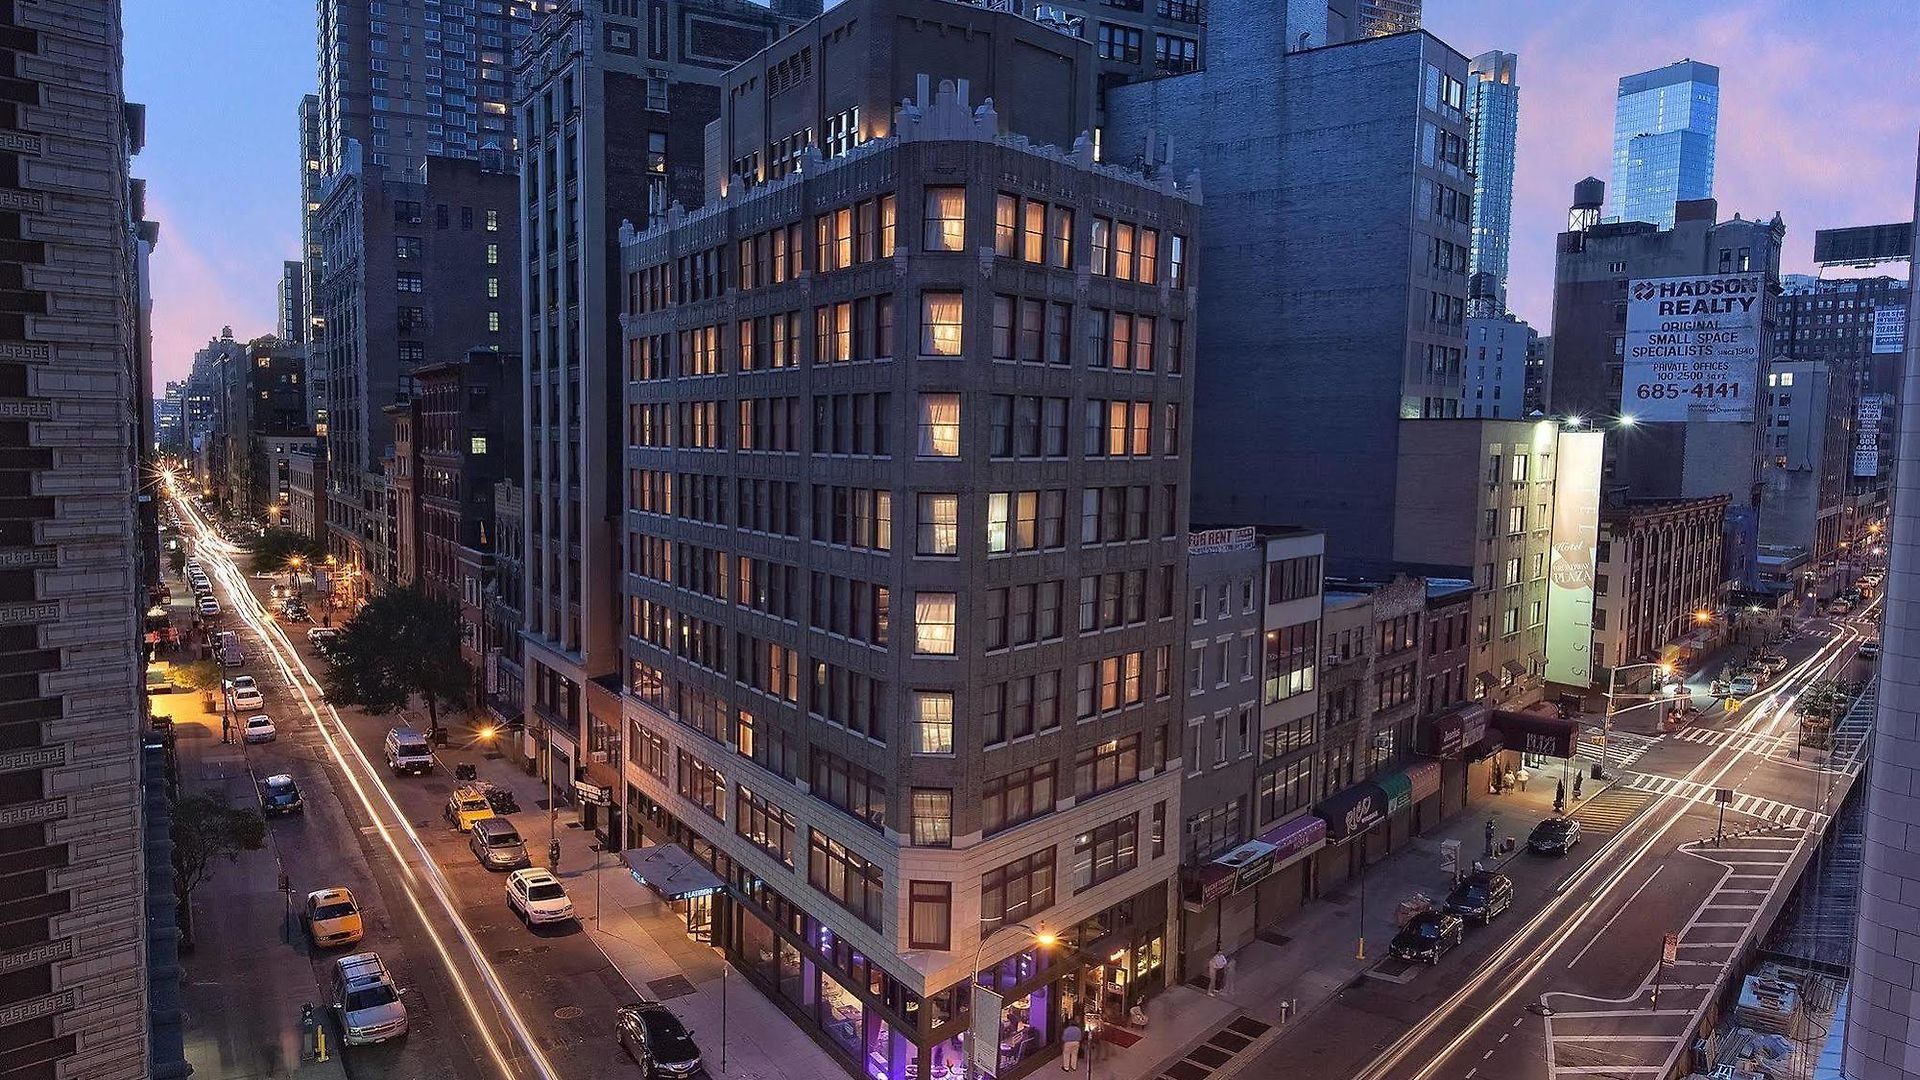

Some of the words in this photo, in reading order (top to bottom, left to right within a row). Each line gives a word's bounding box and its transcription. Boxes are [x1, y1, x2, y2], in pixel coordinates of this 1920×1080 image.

[1660, 278, 1758, 298] HADSON
[1659, 297, 1756, 316] REALTY
[1661, 320, 1720, 333] ORIGINAL
[1648, 334, 1691, 346] SMALL
[1697, 332, 1738, 344] SPACE
[1632, 345, 1713, 358] SPECIALISTS
[1653, 363, 1688, 372] PRIVATE
[1693, 361, 1729, 371] OFFICES
[1636, 382, 1740, 400] 685-4141
[1188, 532, 1206, 547] FOR
[1208, 530, 1233, 545] RENT
[1553, 570, 1592, 584] PLAZA
